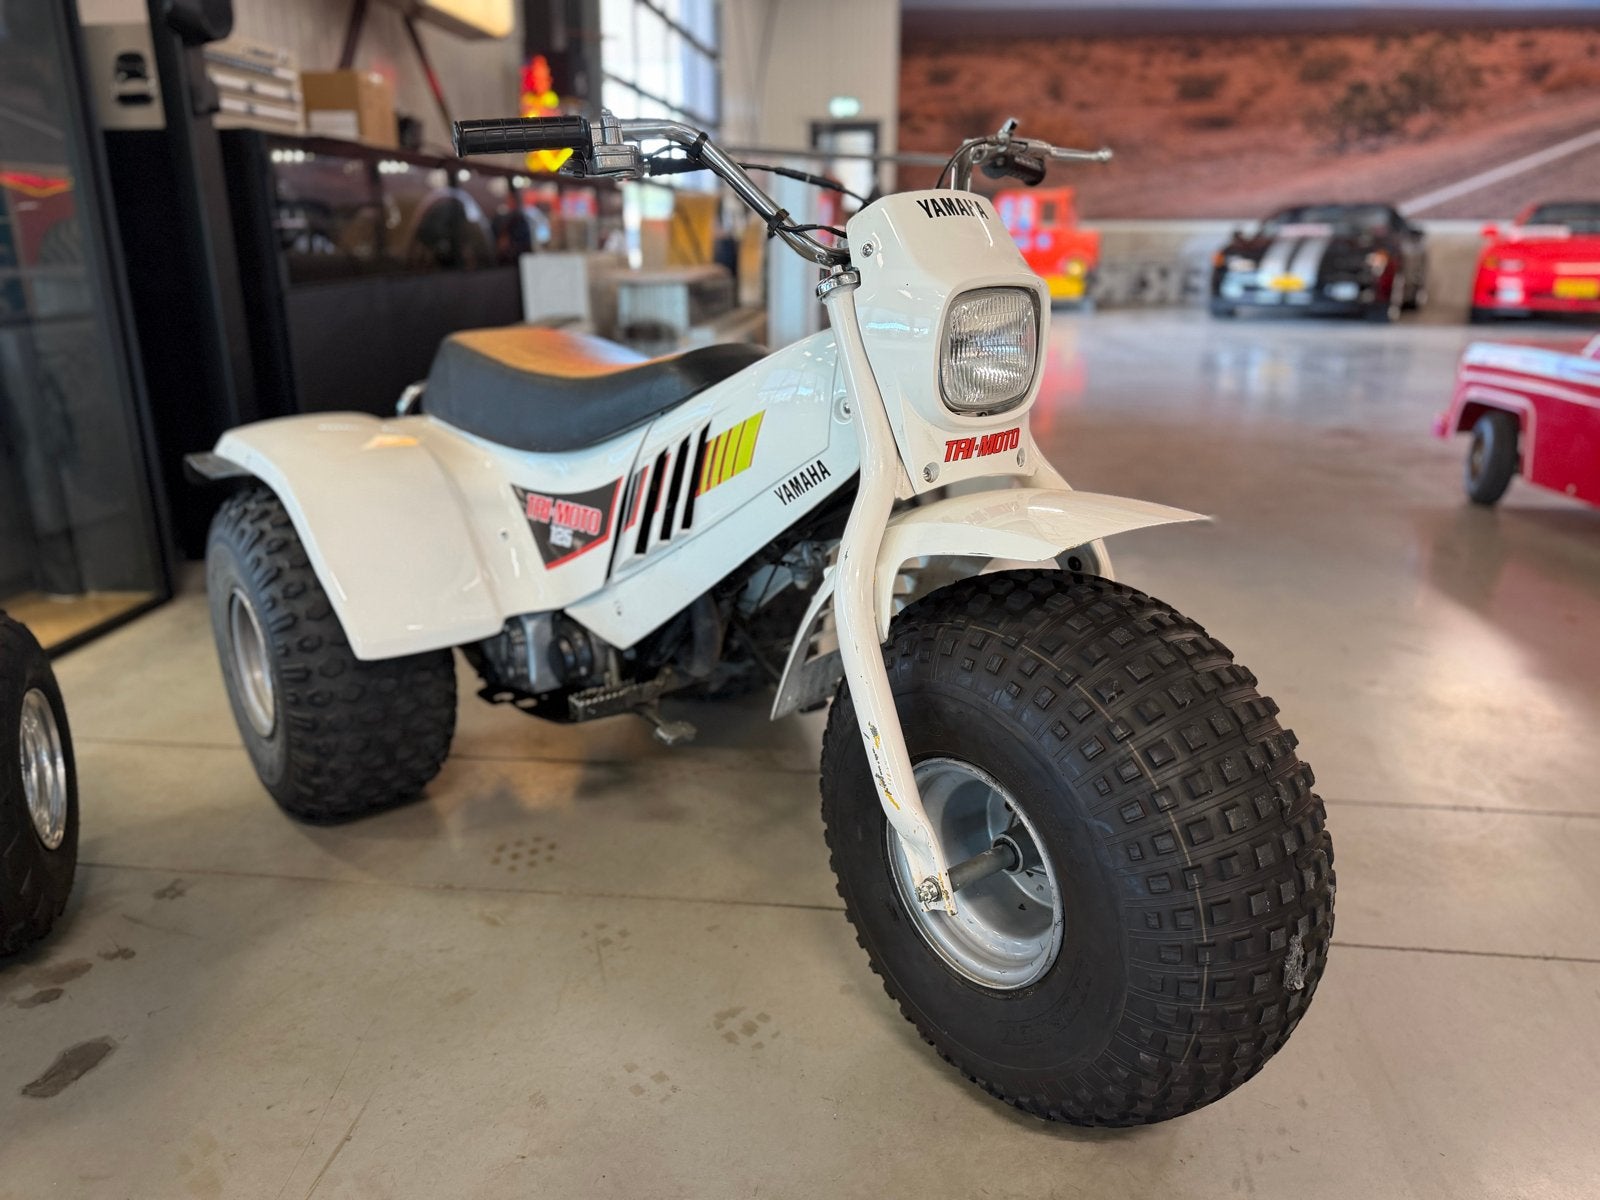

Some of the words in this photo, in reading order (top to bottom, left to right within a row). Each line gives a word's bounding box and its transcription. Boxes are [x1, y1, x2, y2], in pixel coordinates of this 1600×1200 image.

[917, 197, 989, 219] YAMAHA
[944, 427, 1020, 462] TRI-MOTO
[773, 459, 831, 506] YAMAHA
